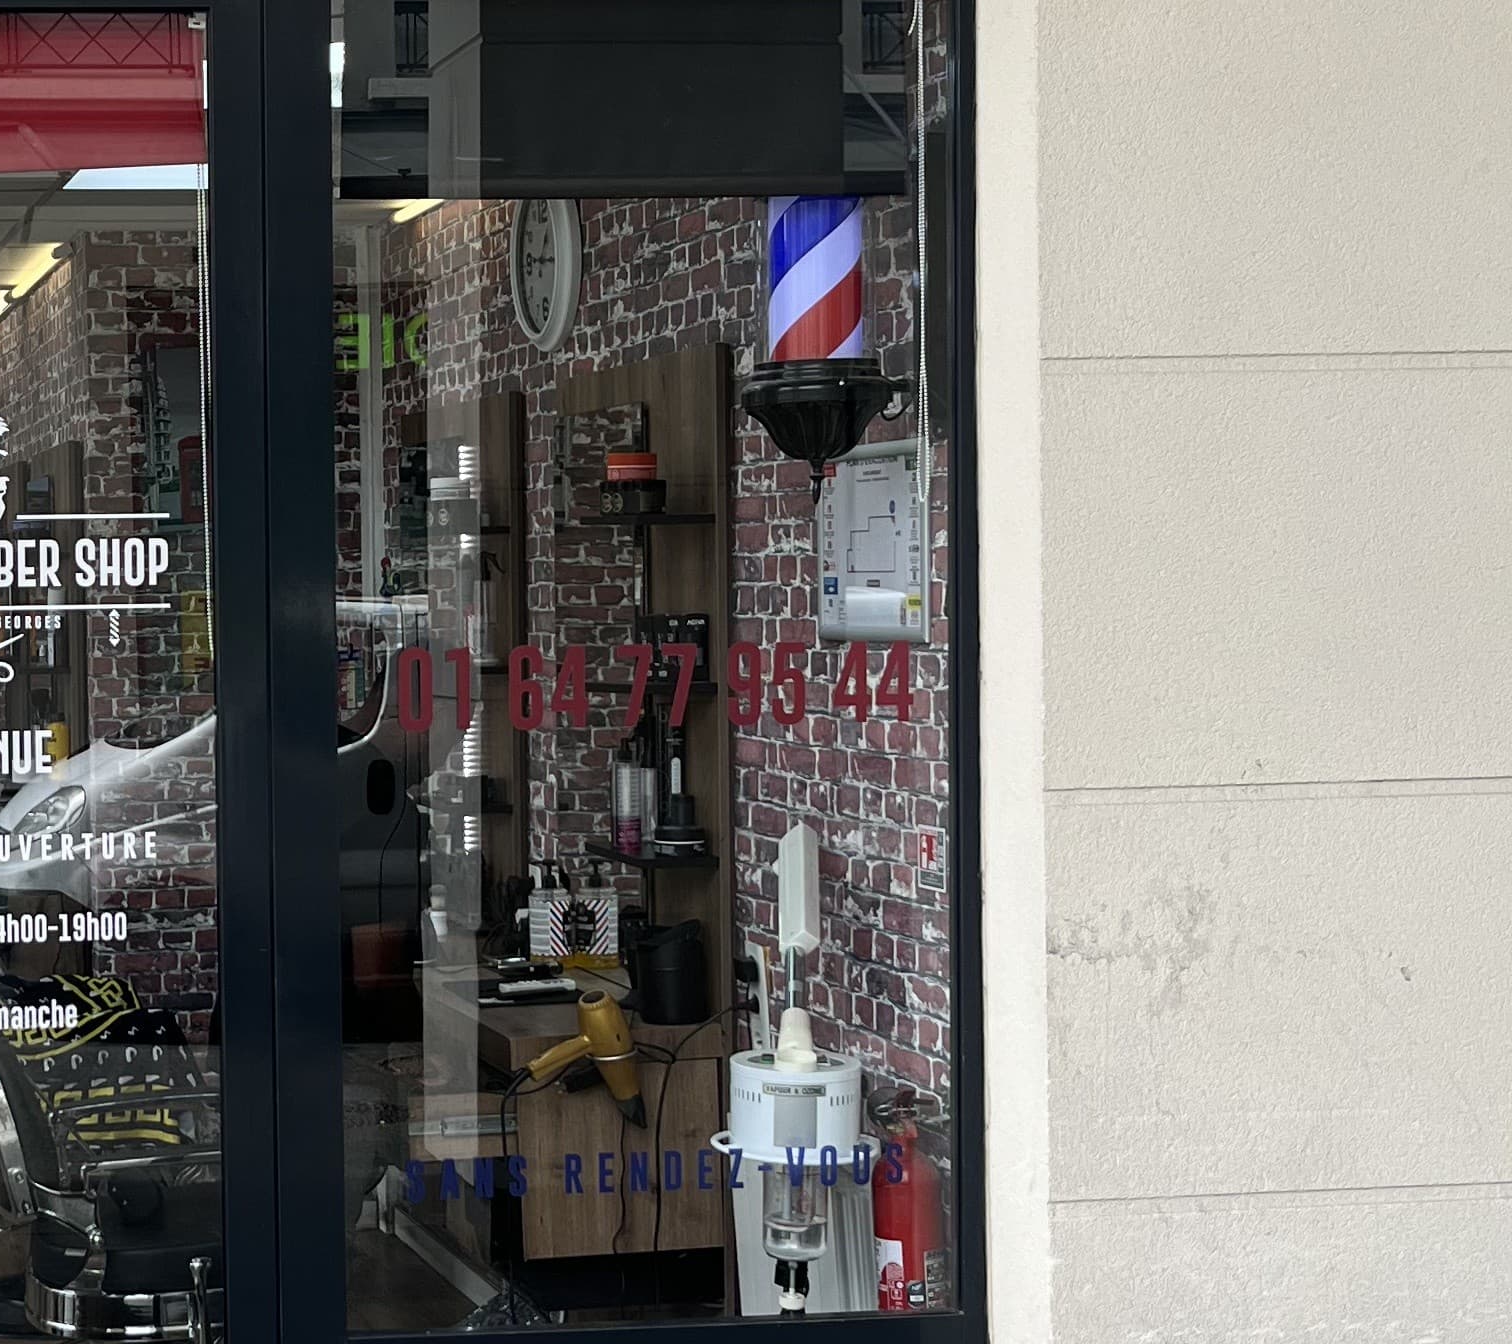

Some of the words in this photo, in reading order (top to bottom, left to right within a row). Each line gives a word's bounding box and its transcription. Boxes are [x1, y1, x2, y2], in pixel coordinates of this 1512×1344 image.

[75, 536, 170, 588] SHOP
[397, 645, 473, 733] 01
[507, 643, 587, 731] 64
[616, 642, 698, 728] 77
[727, 640, 806, 727] 95
[833, 639, 914, 724] 44
[404, 1154, 529, 1205] SANS
[564, 1142, 906, 1194] RENDEZ-VOUS
